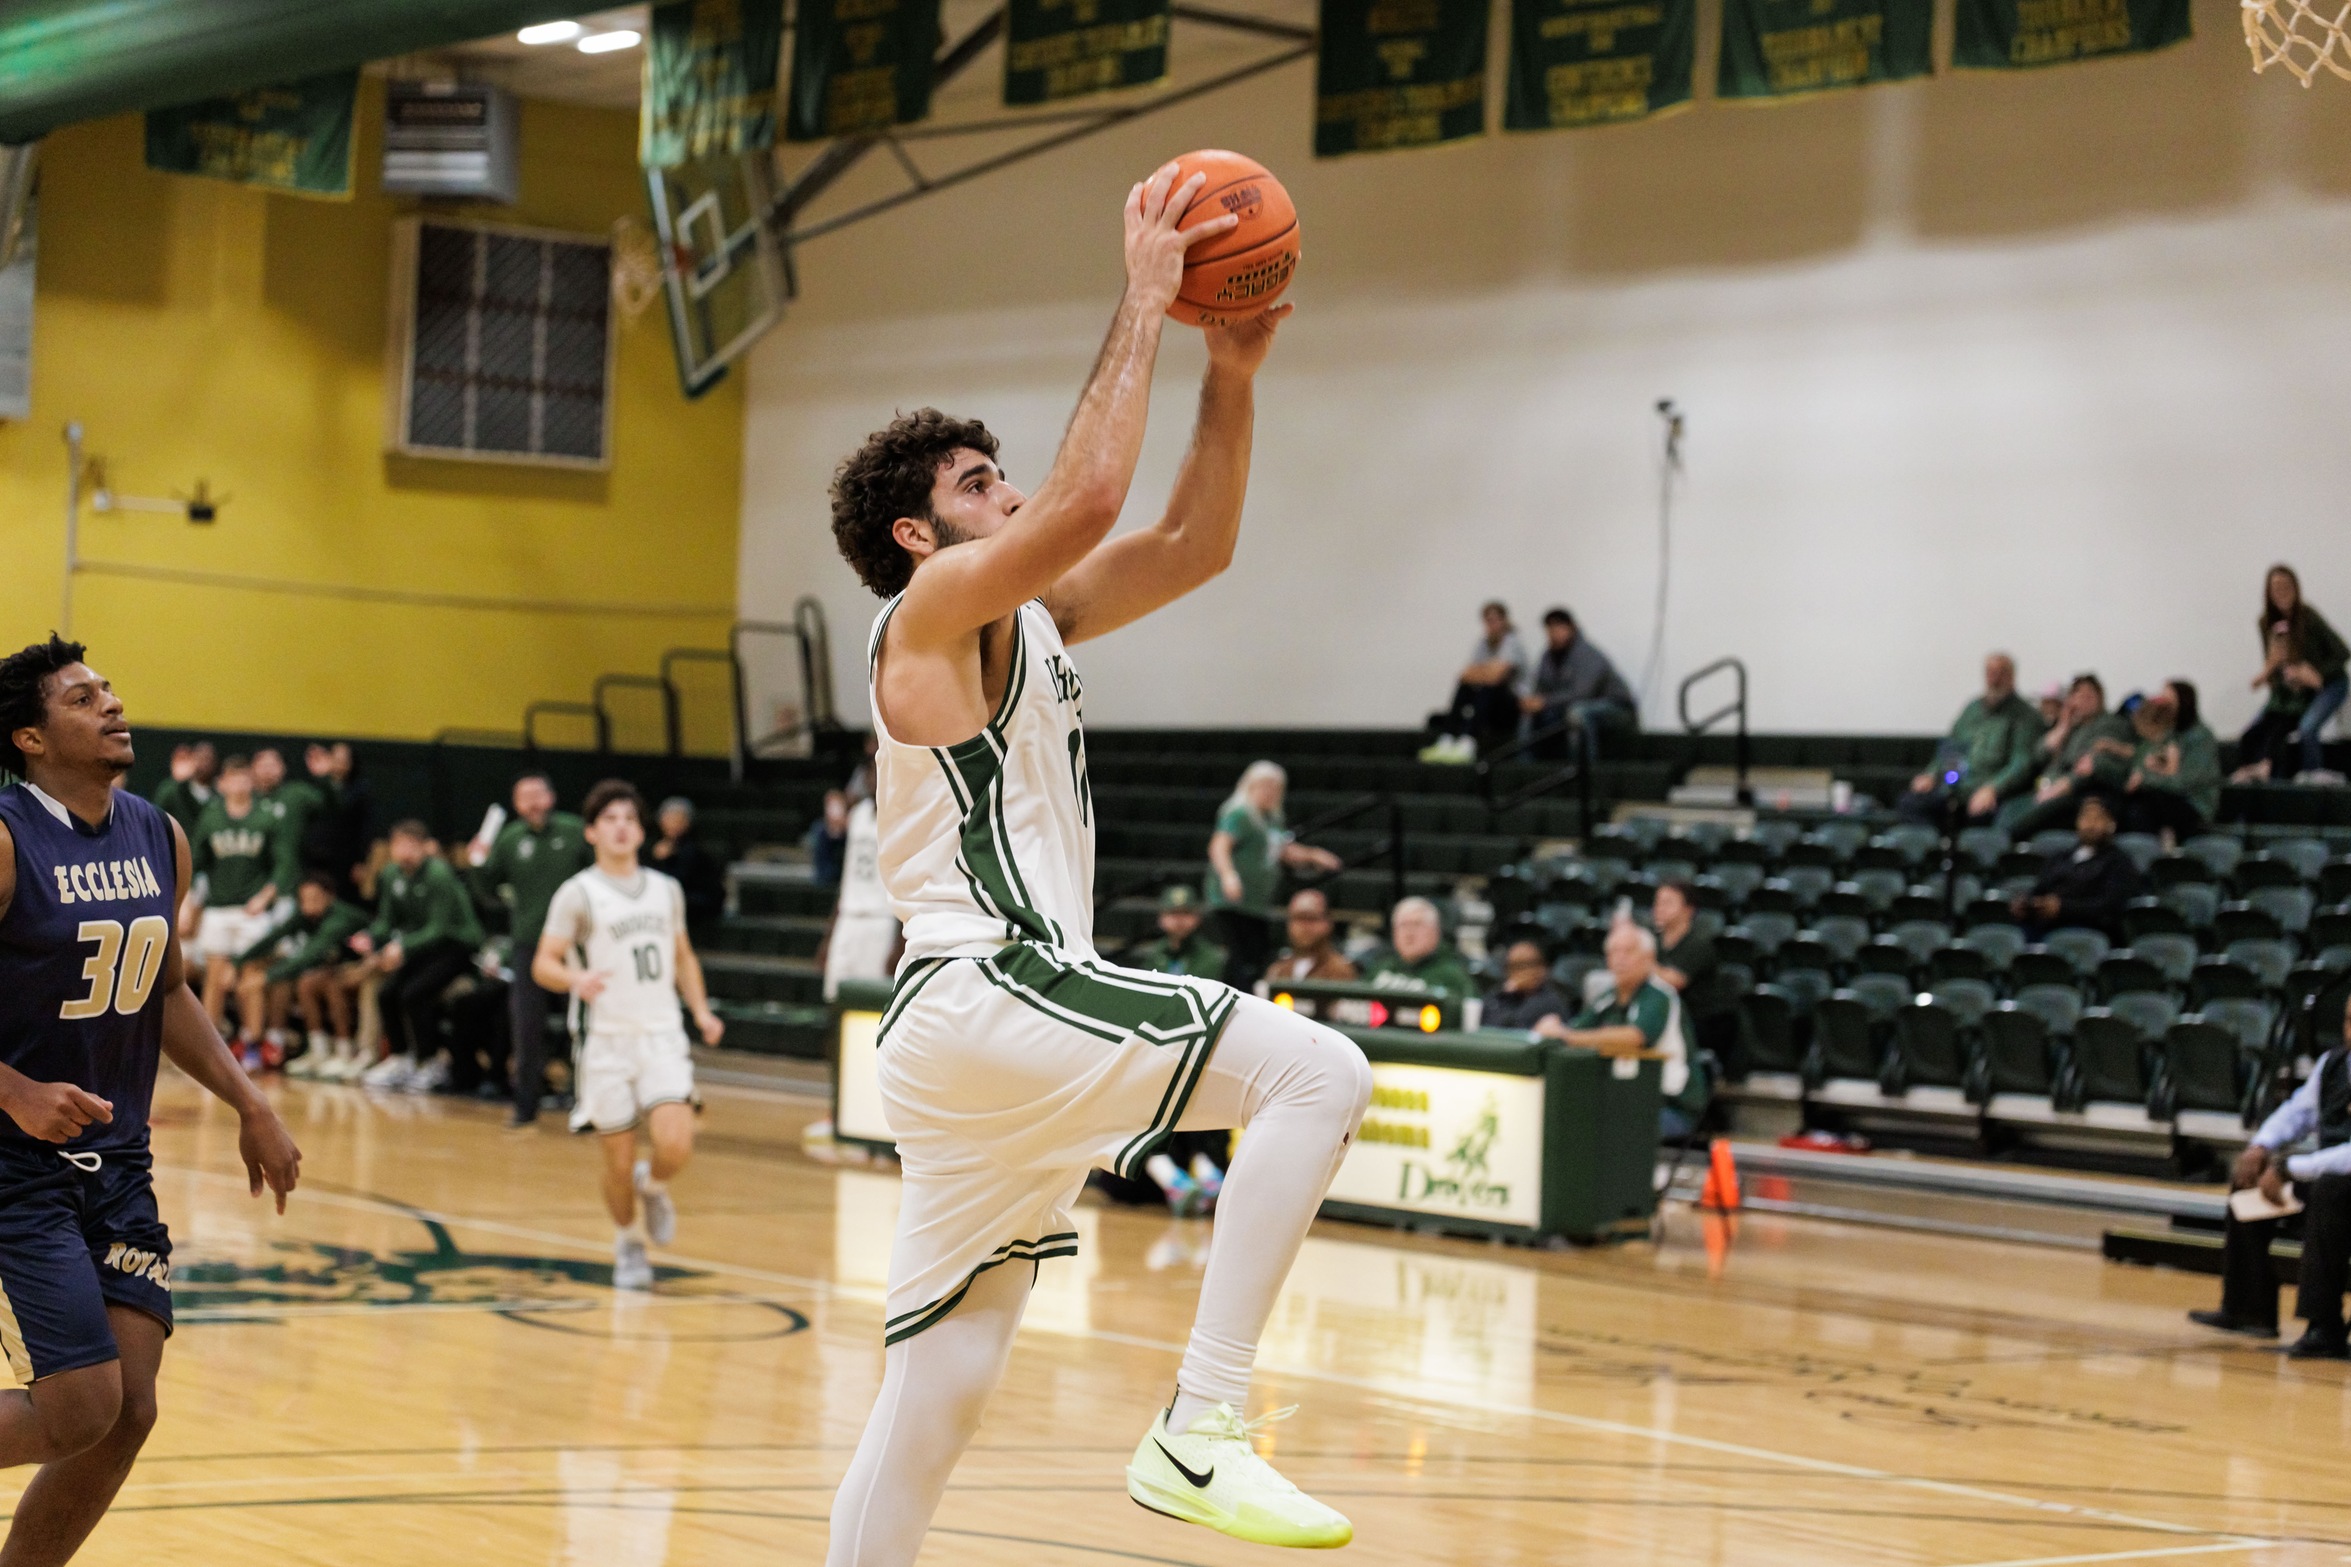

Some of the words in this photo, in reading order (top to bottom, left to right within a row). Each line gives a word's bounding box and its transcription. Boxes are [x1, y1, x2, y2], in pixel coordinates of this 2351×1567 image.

[53, 856, 161, 904] ECCLESIA
[59, 915, 169, 1020] 30
[632, 943, 662, 984] 10
[103, 1242, 171, 1292] ROYAL
